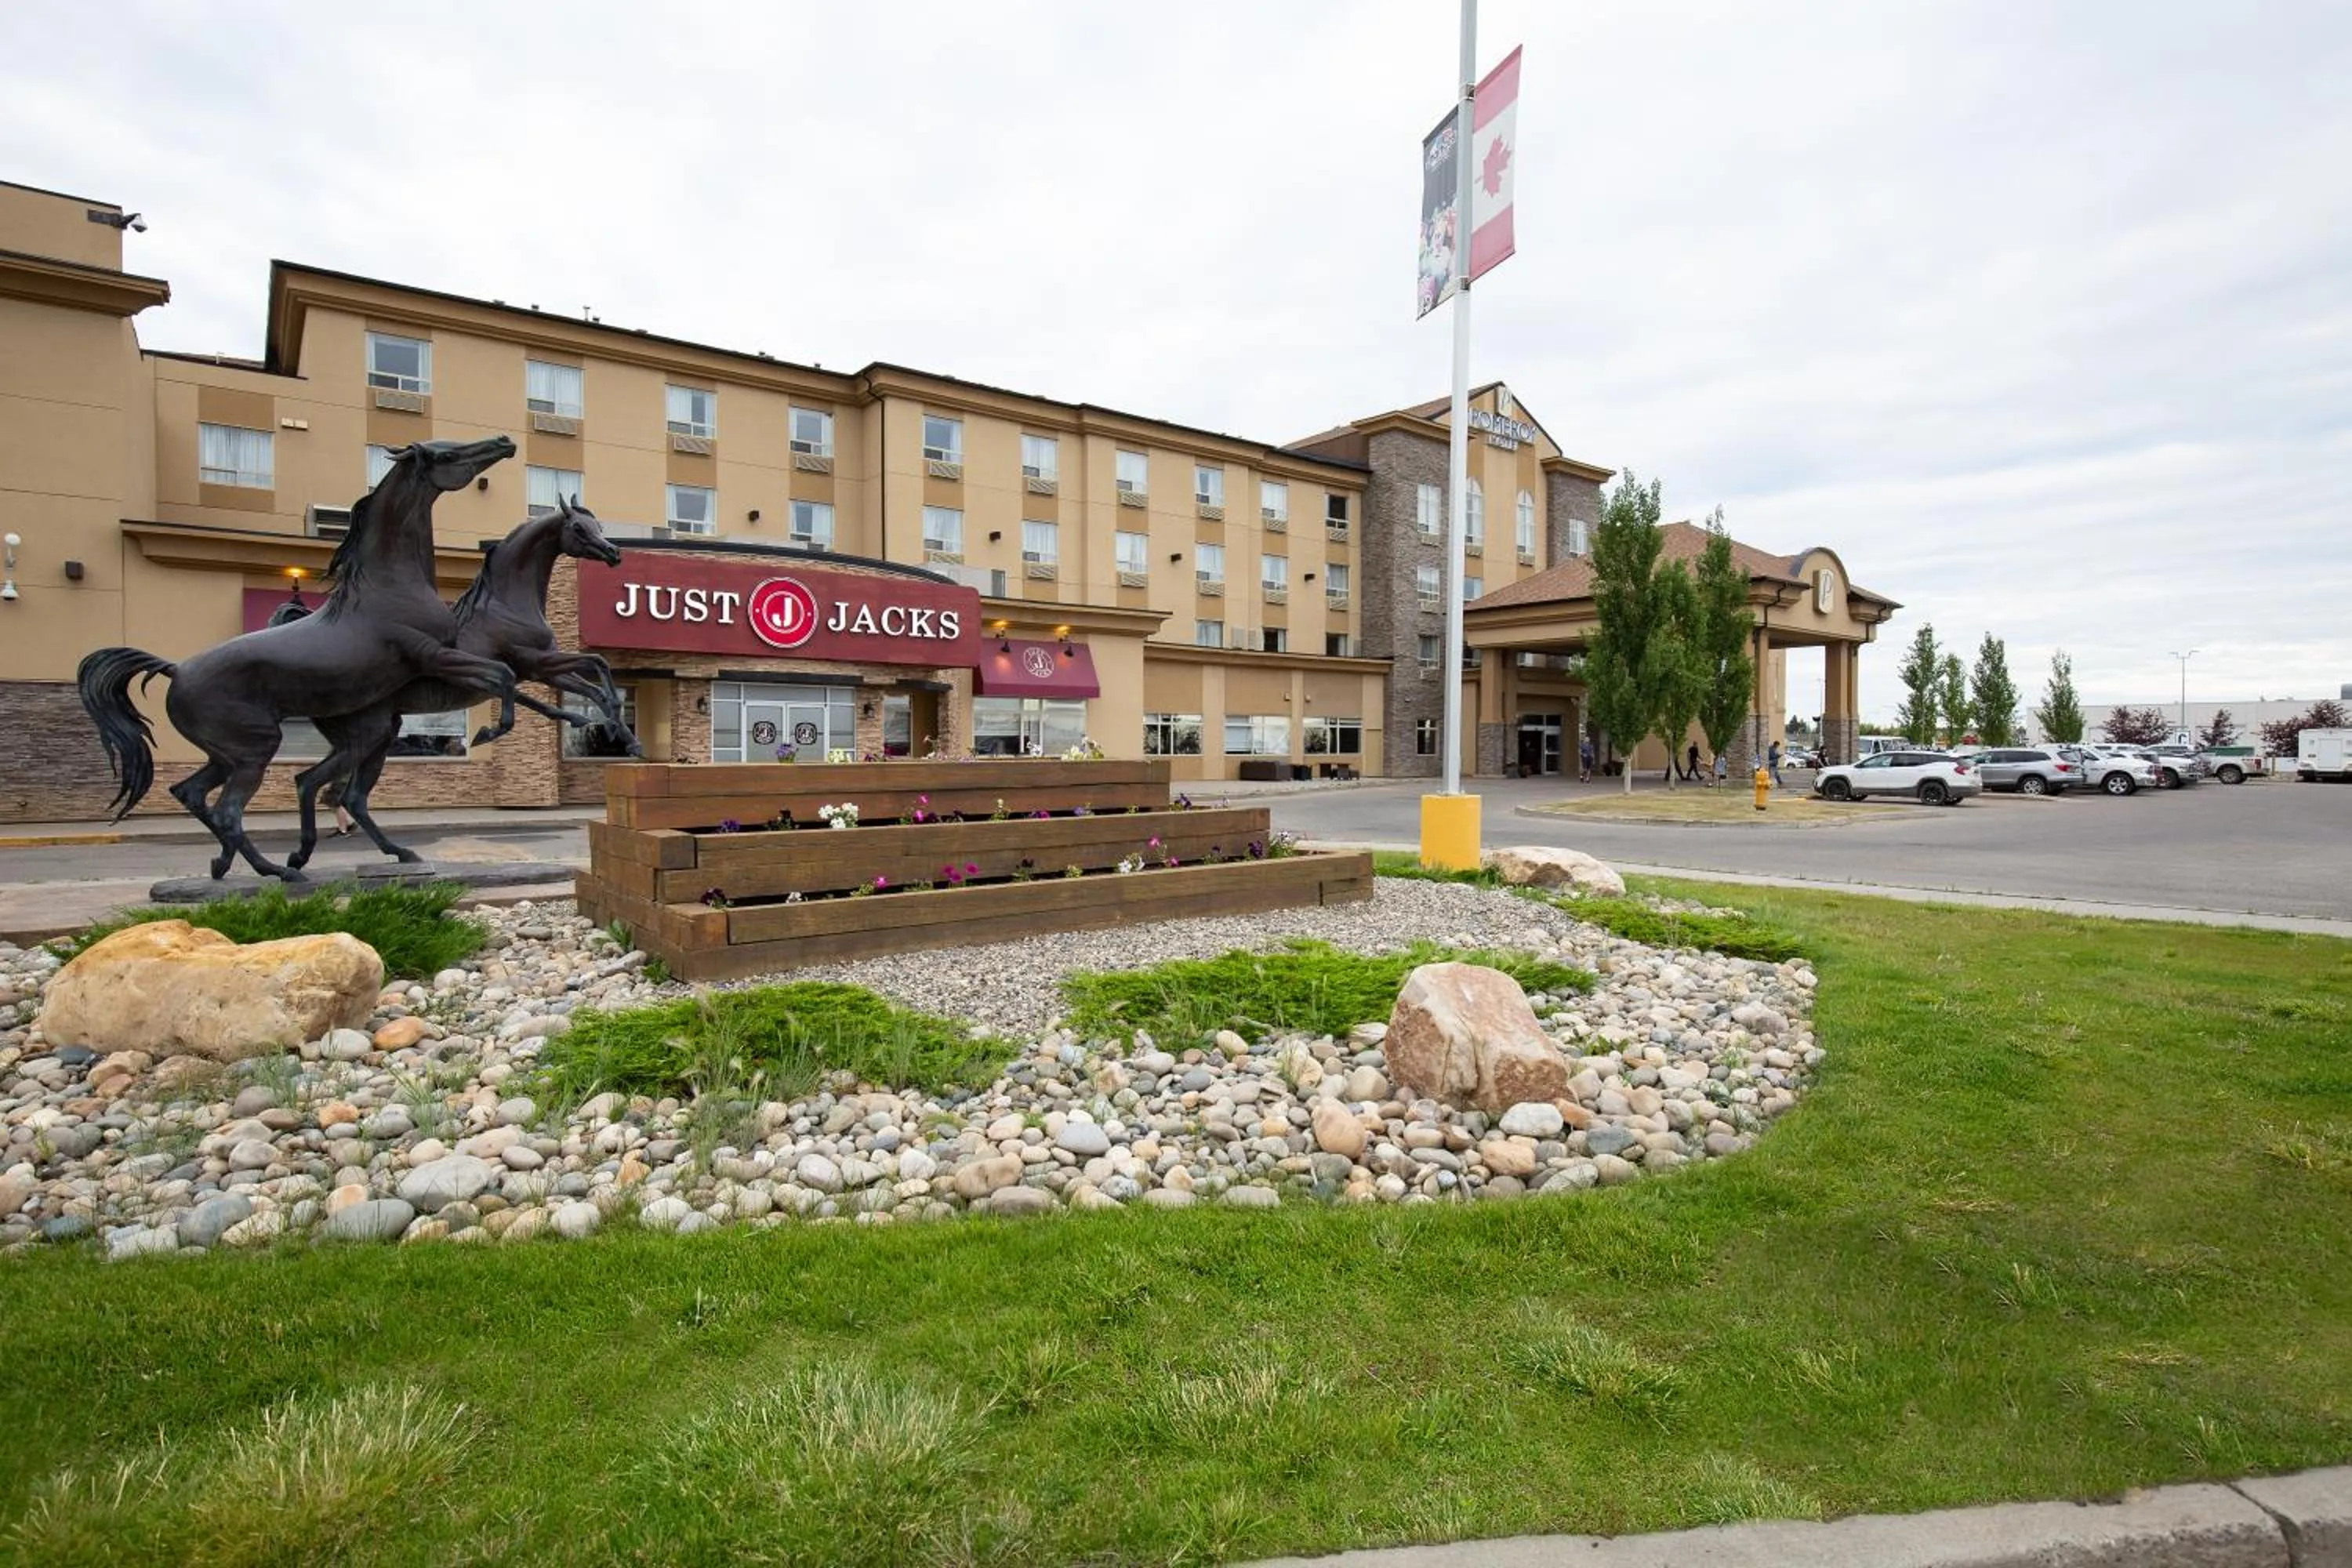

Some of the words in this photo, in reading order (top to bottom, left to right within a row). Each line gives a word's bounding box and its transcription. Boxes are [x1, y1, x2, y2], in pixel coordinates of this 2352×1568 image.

[1468, 408, 1537, 445] POMEROY
[615, 583, 740, 623] JUST
[771, 597, 793, 627] J
[827, 601, 960, 639] JACKS
